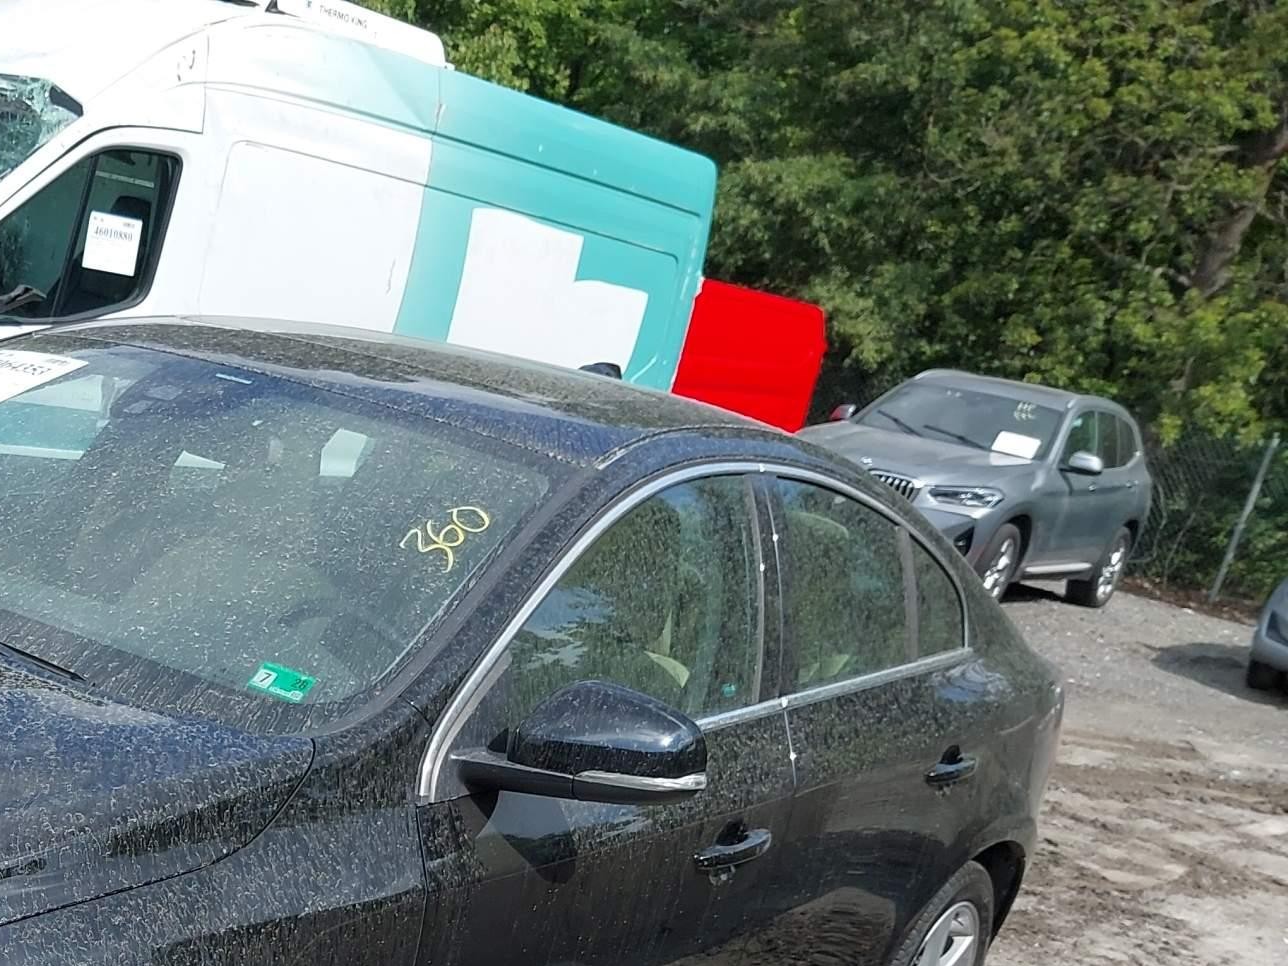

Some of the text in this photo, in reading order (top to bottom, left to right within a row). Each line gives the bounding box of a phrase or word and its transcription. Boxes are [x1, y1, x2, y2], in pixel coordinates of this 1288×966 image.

[319, 4, 349, 23] THERMO
[399, 506, 490, 573] 360
[259, 672, 272, 683] 7
